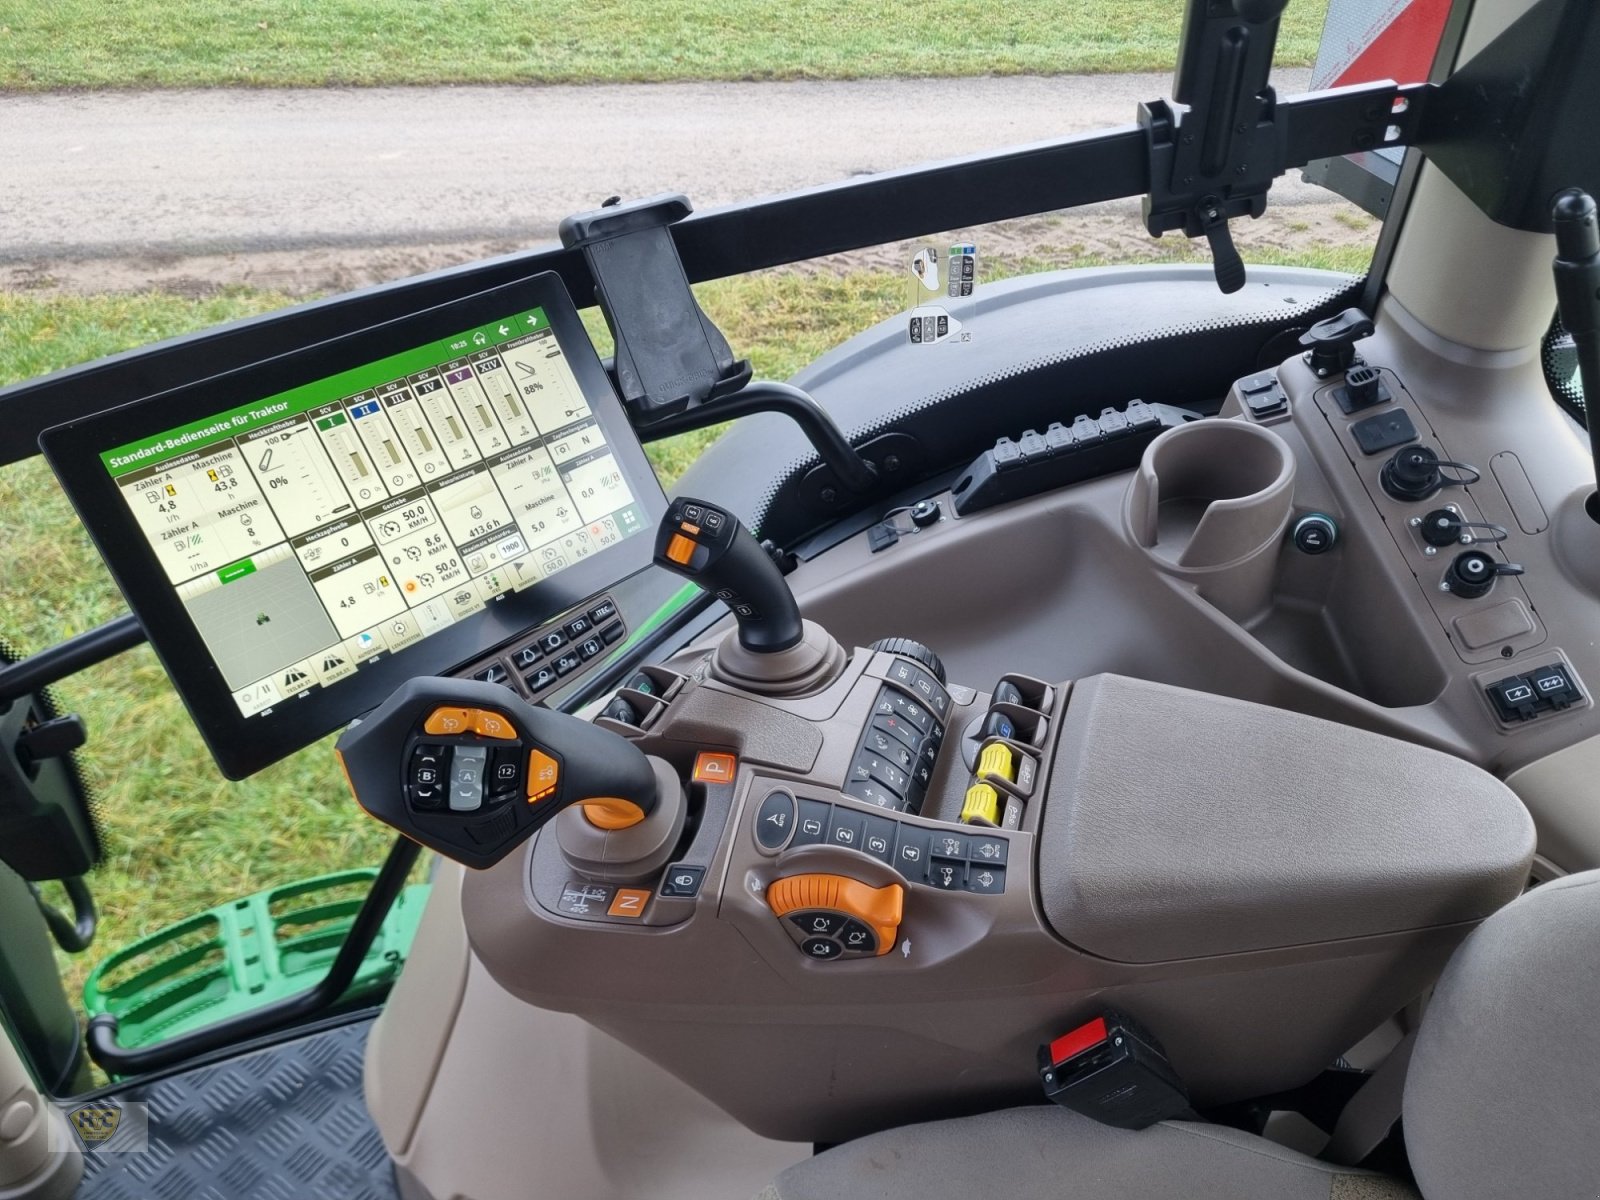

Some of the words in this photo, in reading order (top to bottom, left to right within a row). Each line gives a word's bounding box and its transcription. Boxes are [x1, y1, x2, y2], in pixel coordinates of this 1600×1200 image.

[451, 340, 467, 350] 10:25
[449, 361, 459, 369] SCV
[479, 360, 499, 372] XIV
[418, 372, 429, 380] SCV
[455, 371, 464, 381] V
[387, 383, 398, 391] SCV
[422, 381, 436, 392] IV
[524, 382, 544, 395] 88%
[354, 394, 365, 402] SCV
[390, 392, 405, 404] III
[320, 406, 332, 414] SCV
[360, 404, 371, 415] II
[327, 417, 336, 426] I
[109, 420, 232, 468] Standard-Bedienseite
[231, 414, 249, 426] für
[249, 401, 290, 420] Traktor
[249, 419, 296, 439] Heckkraftheber
[265, 436, 280, 446] 100
[581, 435, 590, 444] N
[154, 453, 200, 472] Auslesedaten
[192, 451, 233, 471] Maschine
[506, 457, 526, 469] Zähler
[133, 476, 163, 491] Zähler
[164, 472, 173, 481] A
[213, 478, 239, 494] 43,8
[268, 475, 289, 489] 0%
[227, 492, 235, 500] h
[581, 488, 595, 500] 0,0
[157, 500, 178, 515] 4,8
[218, 499, 259, 518] Maschine
[382, 497, 407, 511] Getriebe
[525, 494, 555, 511] Maschine
[408, 516, 428, 529] KM/H
[468, 522, 493, 539] 413,6
[492, 518, 500, 527] h
[531, 521, 546, 533] 5,0
[161, 525, 190, 540] Zähler
[190, 520, 199, 529] A
[247, 527, 256, 537] 8
[340, 537, 349, 547] 0
[502, 541, 519, 553] 1900
[428, 543, 448, 556] KM/H
[441, 569, 461, 581] KM/H
[339, 596, 357, 610] 4,8
[454, 592, 472, 605] ISO
[595, 606, 610, 617] ITEC
[705, 761, 725, 773] P
[422, 771, 431, 780] B
[464, 772, 471, 780] A
[807, 822, 818, 832] 1
[840, 830, 851, 840] 2
[872, 839, 883, 849] 3
[905, 848, 917, 859] 4
[619, 896, 640, 909] N
